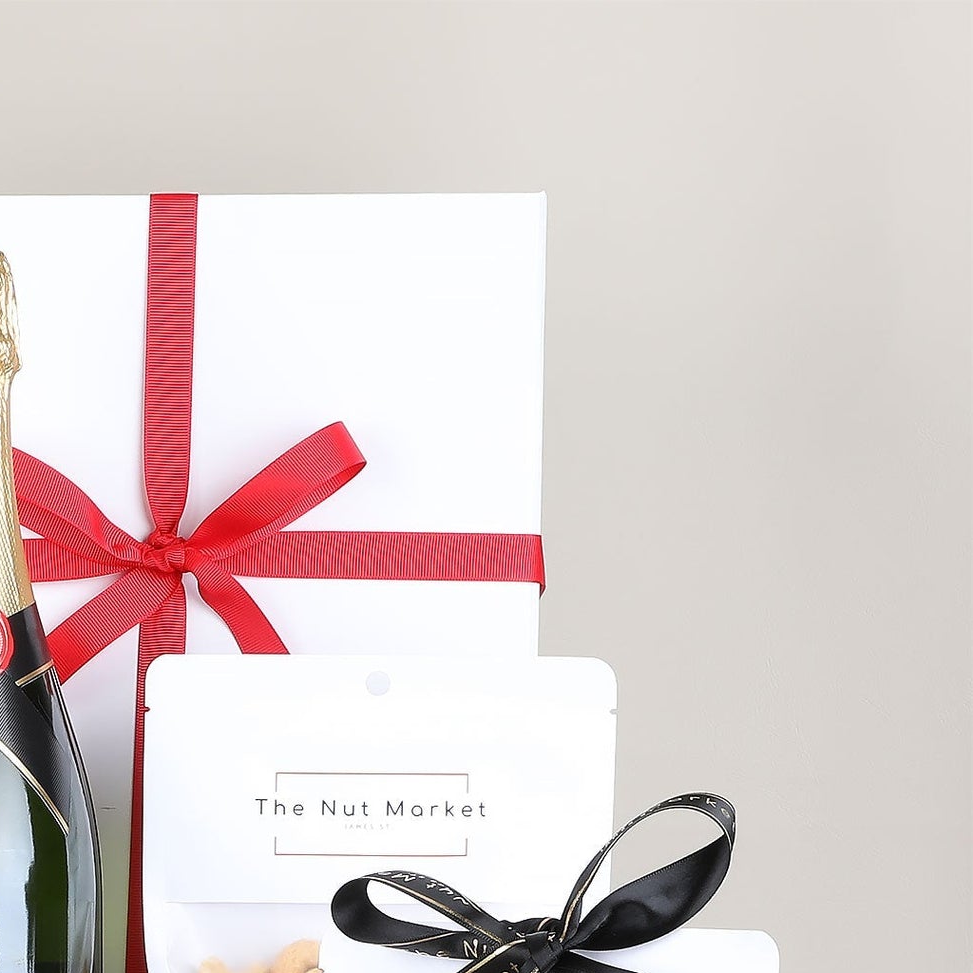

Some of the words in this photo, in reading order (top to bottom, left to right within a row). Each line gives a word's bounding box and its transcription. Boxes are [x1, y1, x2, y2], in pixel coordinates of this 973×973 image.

[255, 798, 304, 816] The
[321, 800, 369, 817] Nut
[385, 800, 486, 817] Market
